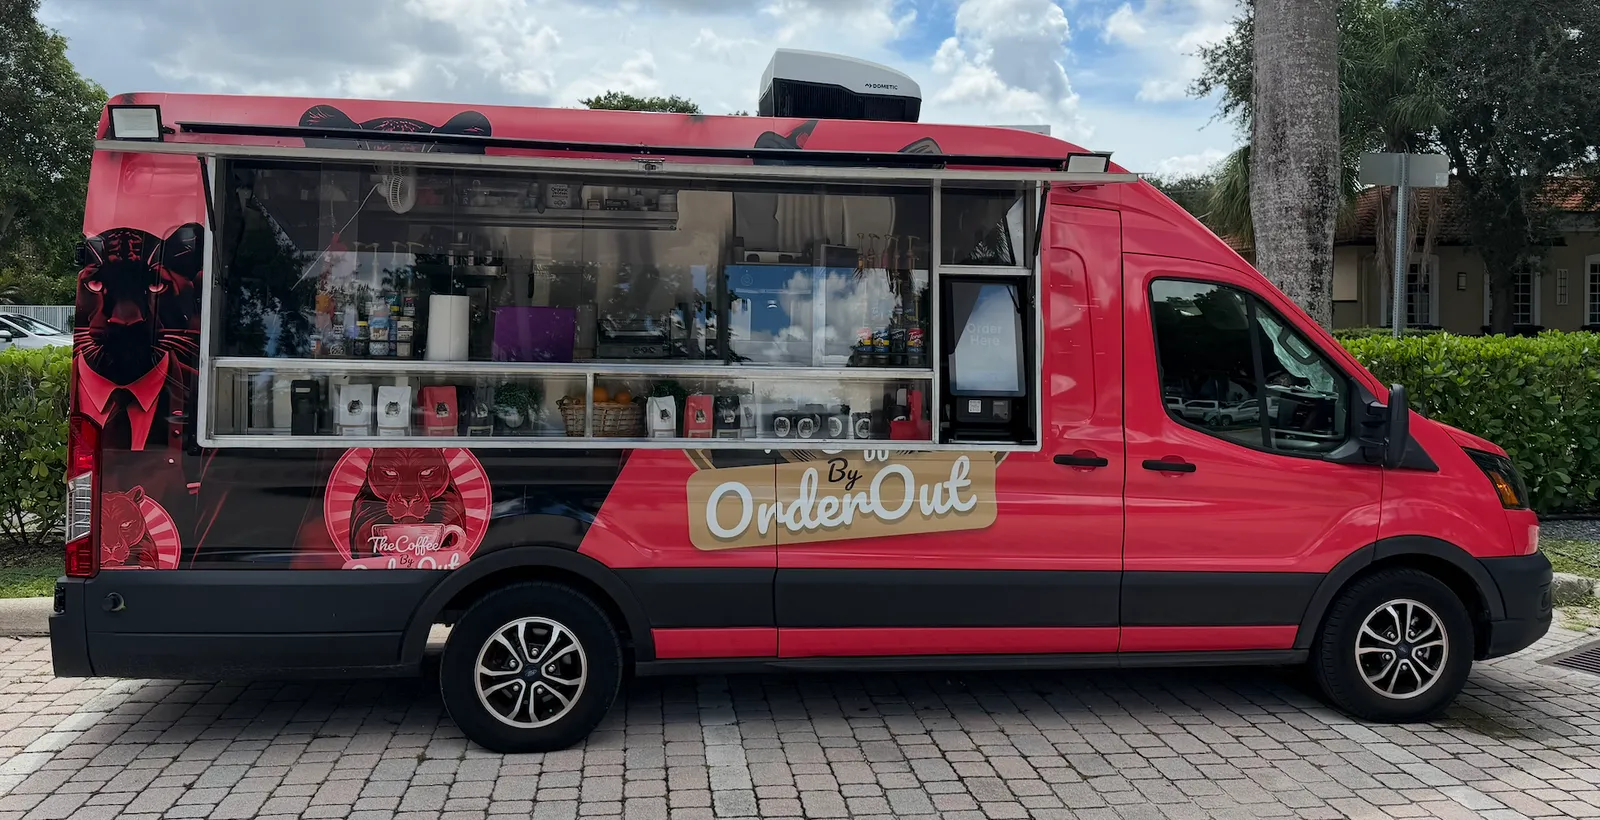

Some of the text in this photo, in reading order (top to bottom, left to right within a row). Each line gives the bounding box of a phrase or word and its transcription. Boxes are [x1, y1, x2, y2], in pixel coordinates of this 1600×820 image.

[872, 83, 898, 91] DOMETIC
[966, 323, 1002, 334] Order
[970, 335, 1000, 346] Here
[827, 457, 863, 491] By
[706, 456, 977, 539] OrderOut
[400, 554, 414, 568] By
